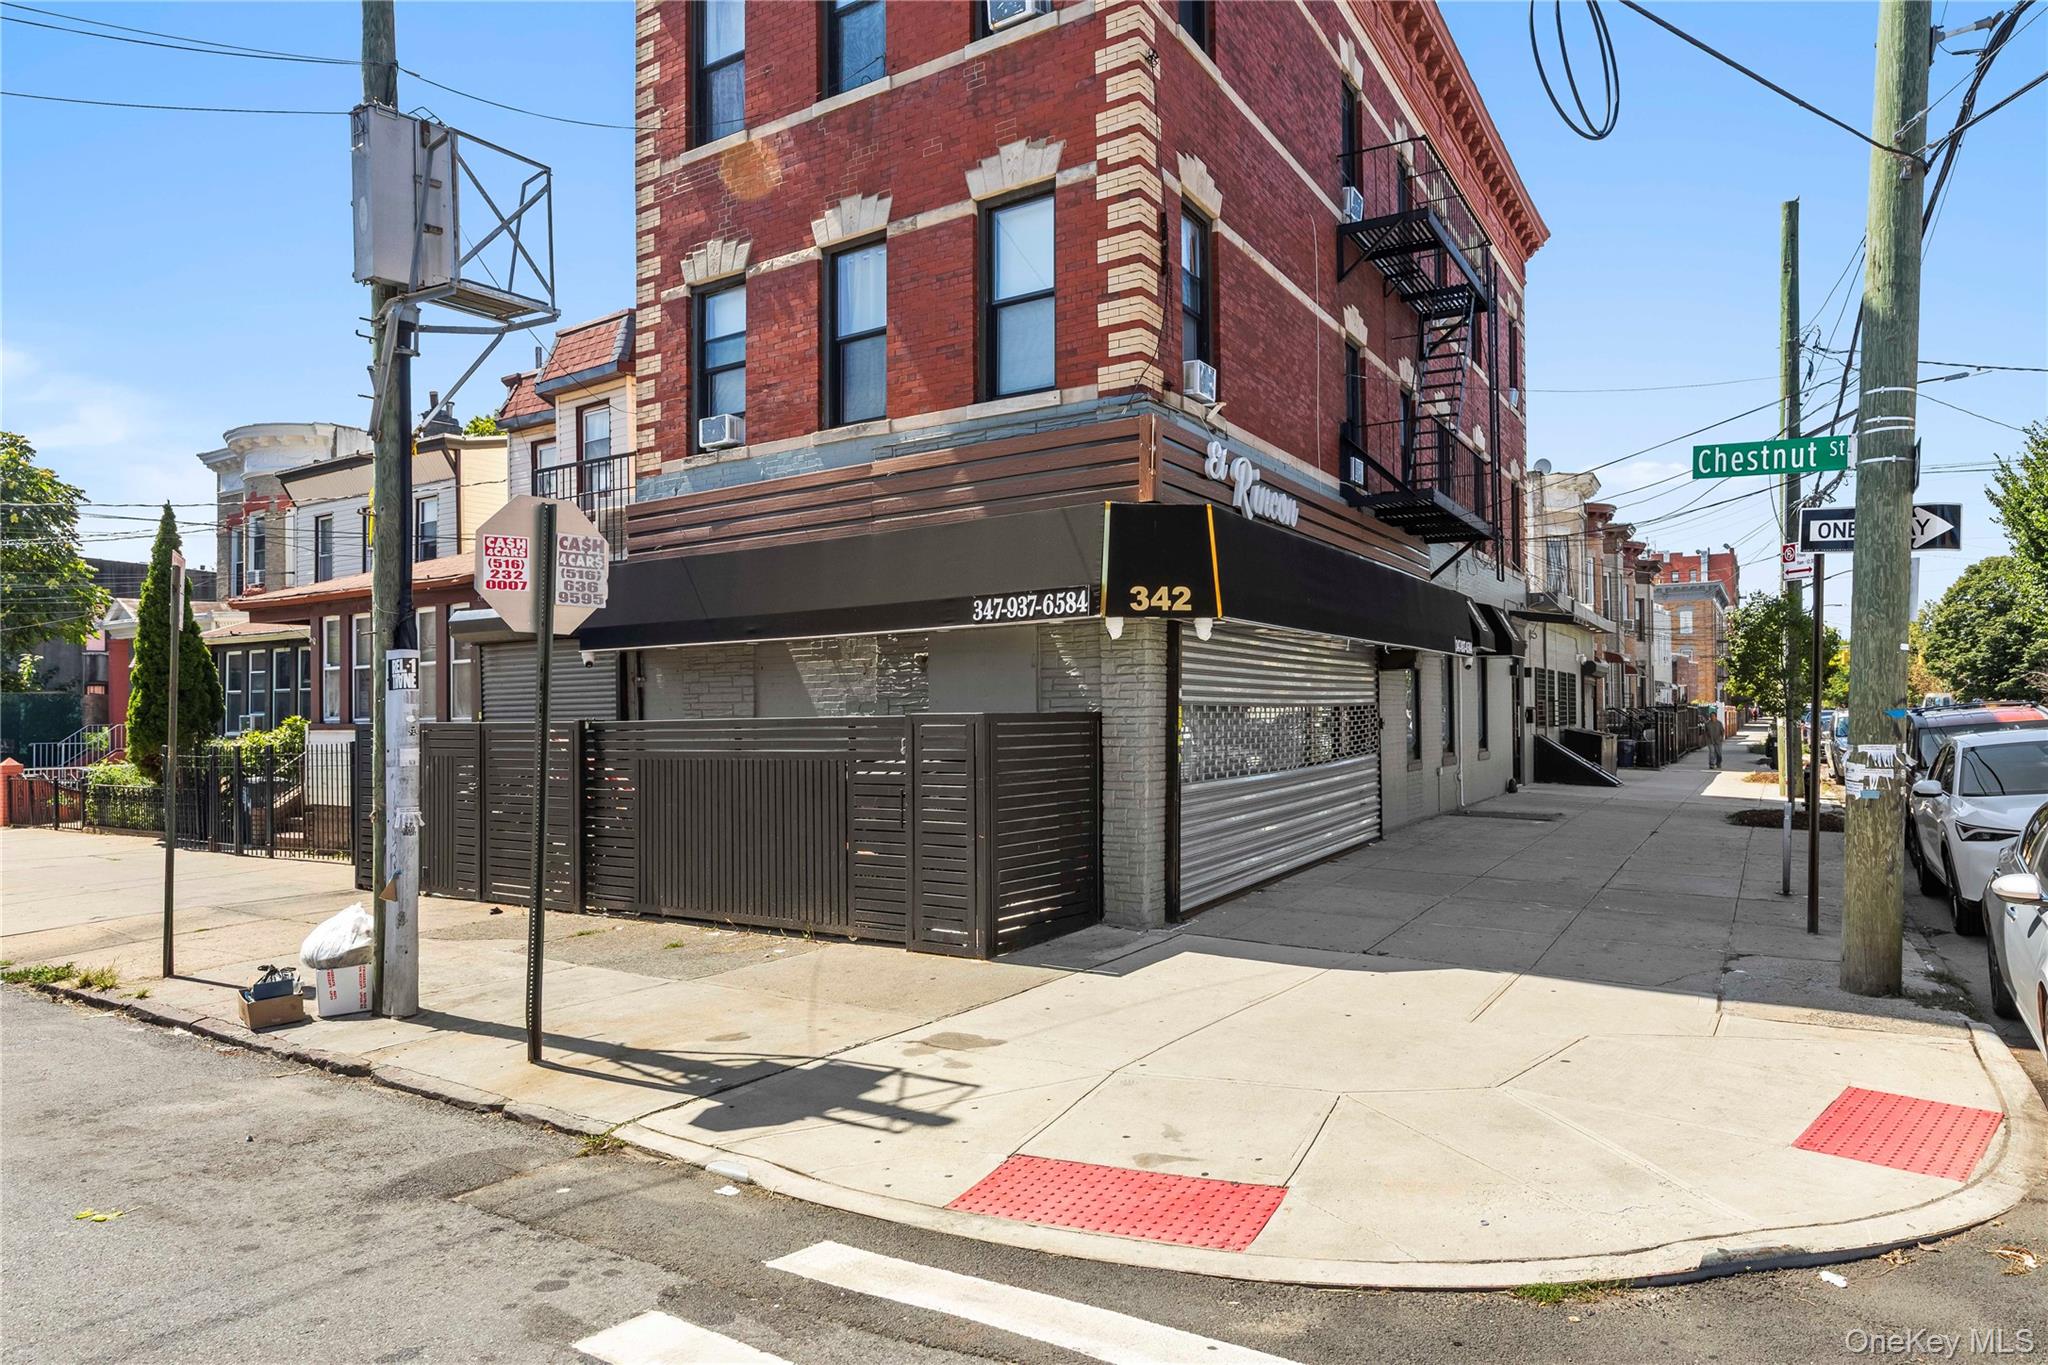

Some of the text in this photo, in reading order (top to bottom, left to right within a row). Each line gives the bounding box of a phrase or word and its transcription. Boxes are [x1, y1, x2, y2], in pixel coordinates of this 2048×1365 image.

[1698, 440, 1845, 474] Chestnut St
[559, 536, 604, 554] CA$H
[488, 558, 525, 570] (516)
[490, 569, 523, 580] 232
[561, 568, 601, 581] (516)
[486, 580, 527, 590] 0007
[563, 580, 599, 593] 636
[558, 591, 604, 605] 9595
[1129, 585, 1192, 612] 342
[972, 590, 1088, 621] 347-937-6584
